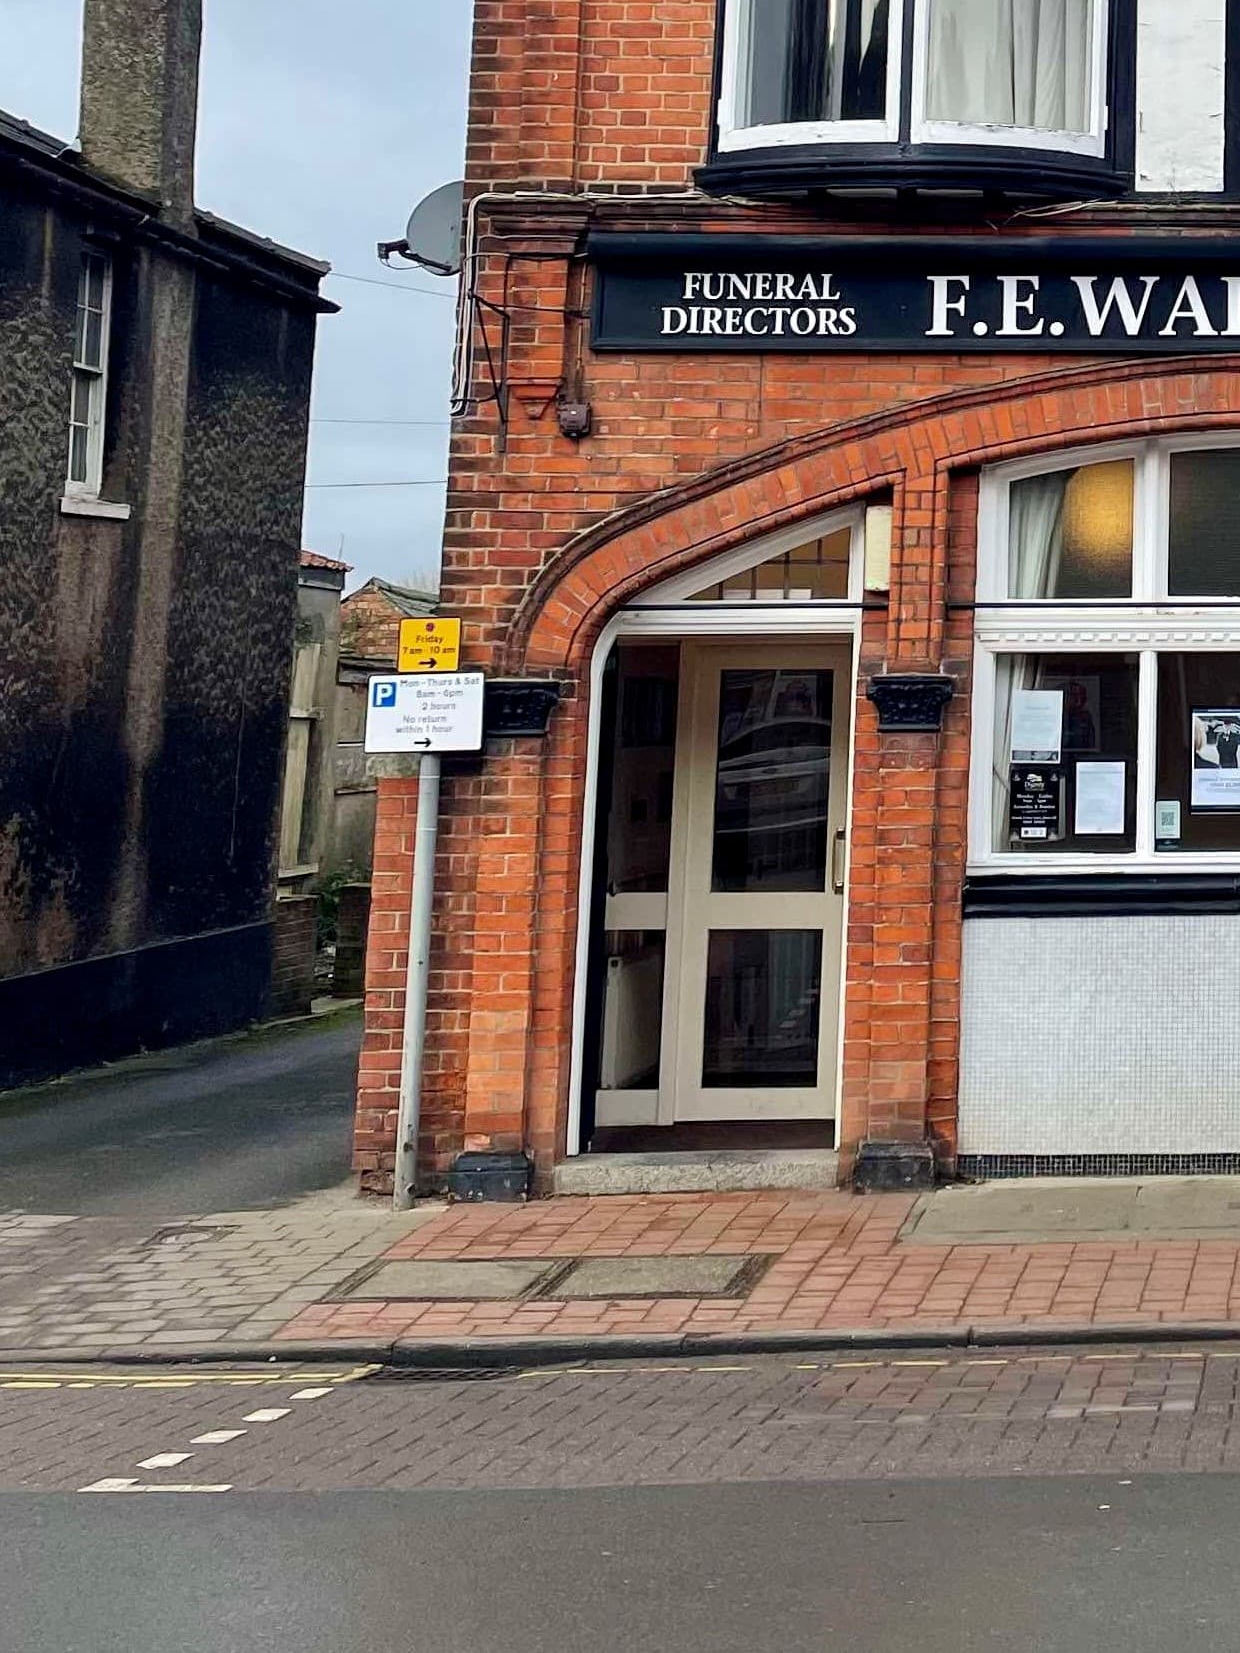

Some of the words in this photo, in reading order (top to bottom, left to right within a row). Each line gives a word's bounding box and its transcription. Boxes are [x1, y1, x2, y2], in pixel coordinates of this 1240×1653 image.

[682, 272, 841, 300] FUNERAL
[660, 306, 857, 336] DIRECTORS
[416, 635, 444, 644] Friday
[430, 646, 440, 654] 10
[427, 678, 453, 687] Thurs
[464, 677, 480, 685] Sat
[376, 684, 393, 706] P
[403, 715, 416, 723] No
[417, 715, 447, 723] return
[396, 725, 423, 733] within
[431, 725, 453, 733] hour
